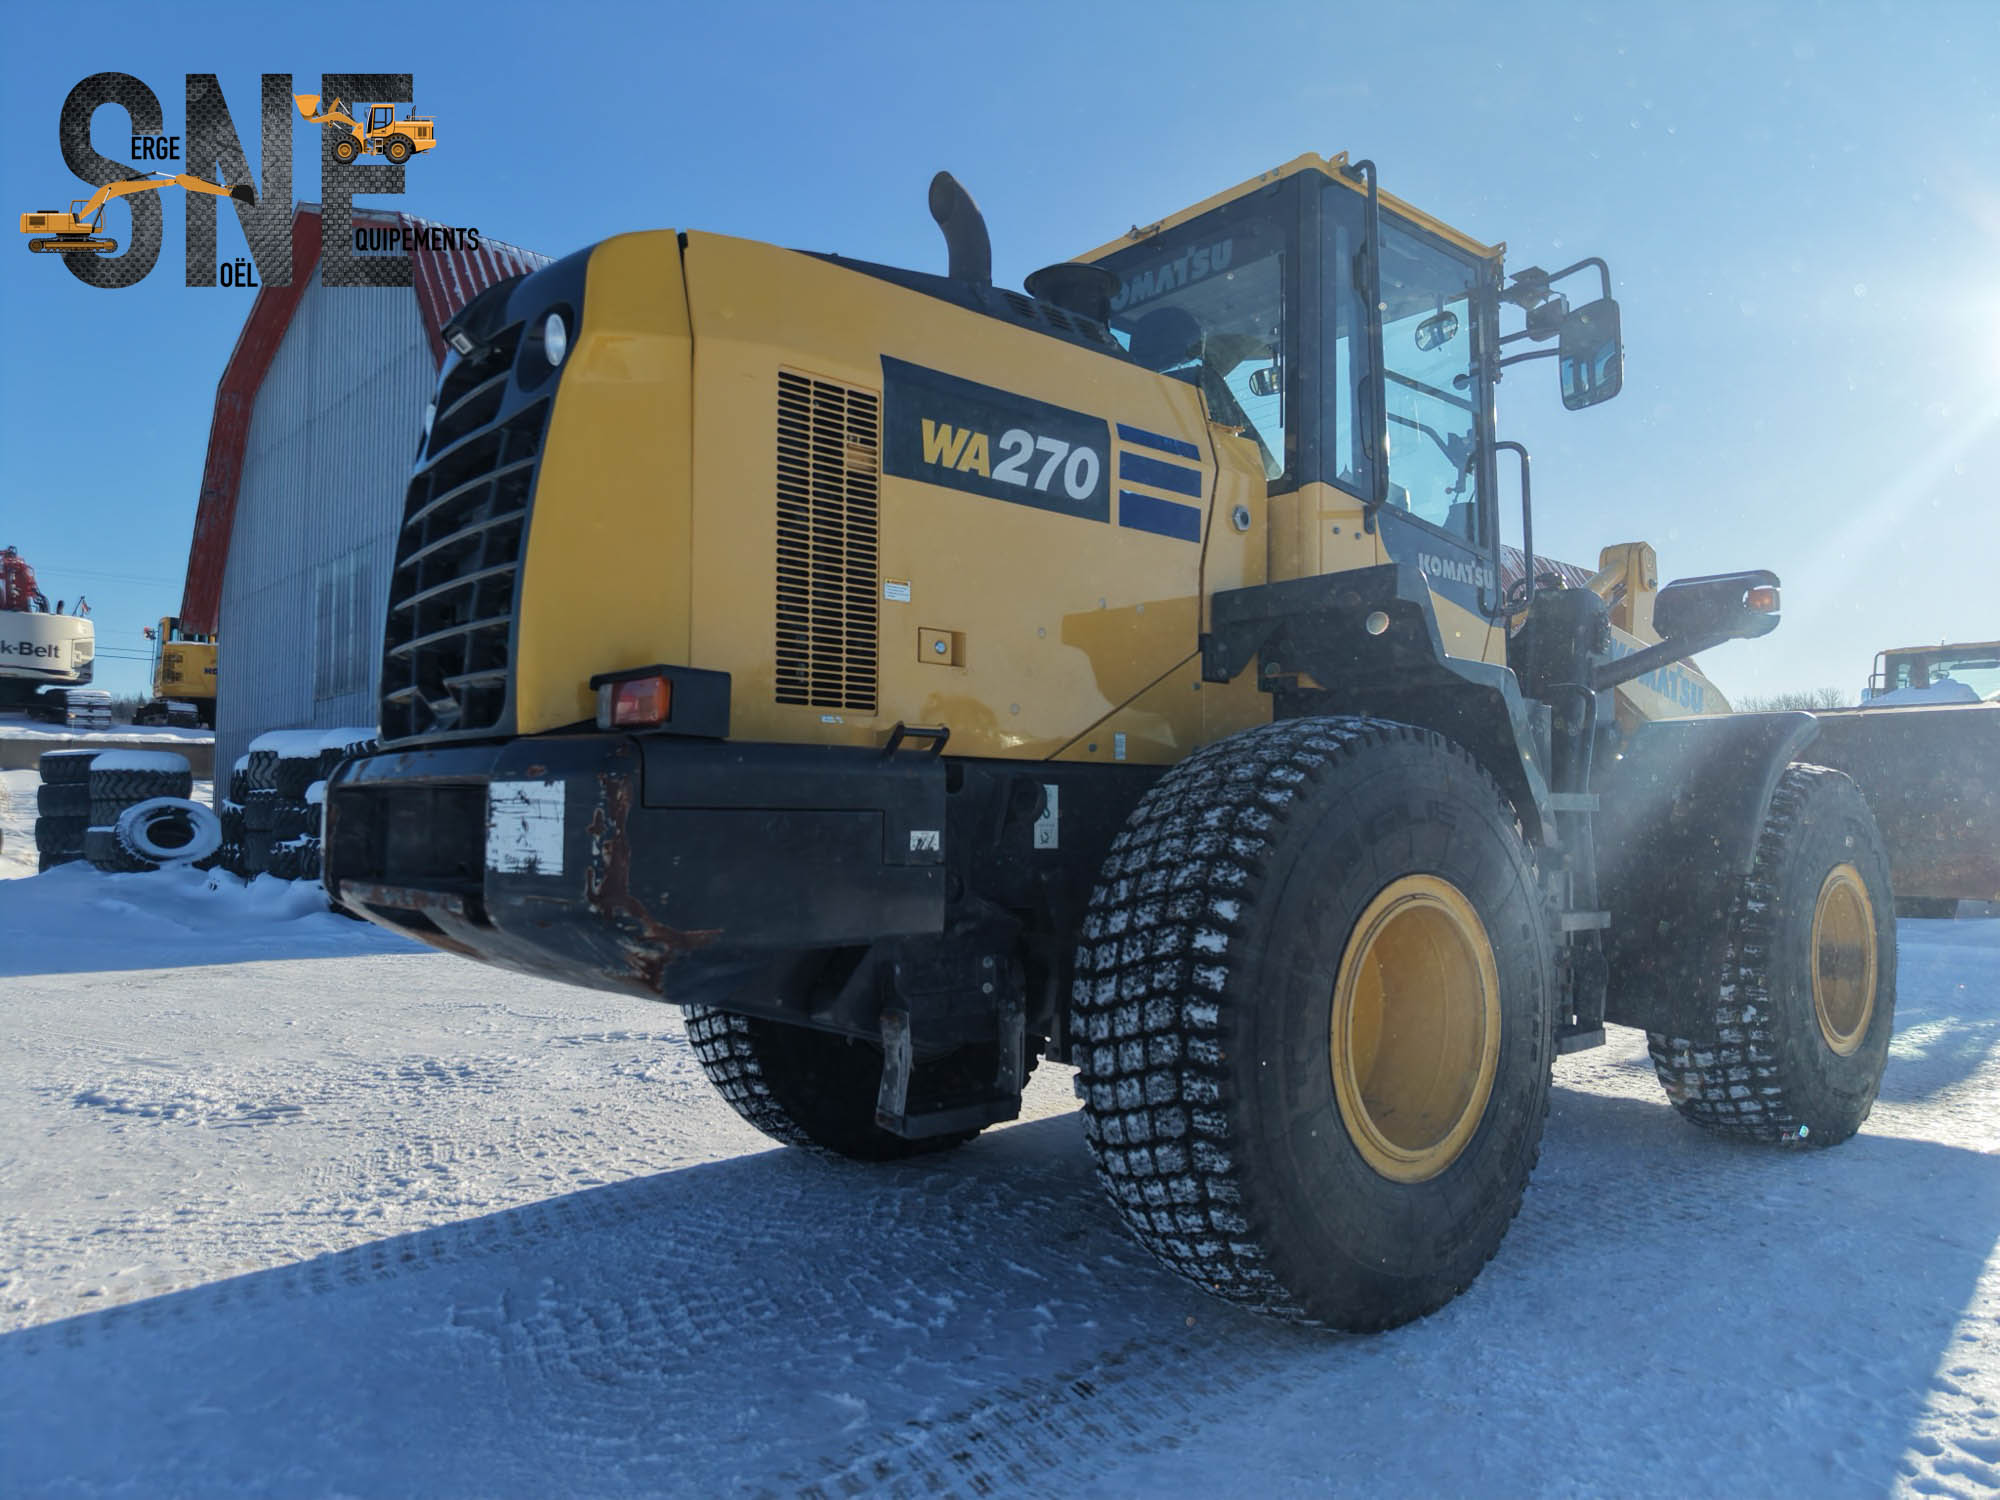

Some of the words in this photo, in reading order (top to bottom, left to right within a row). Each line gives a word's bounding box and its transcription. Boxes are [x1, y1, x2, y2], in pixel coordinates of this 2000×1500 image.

[1108, 238, 1232, 312] OMATSU
[920, 417, 1100, 500] WA270
[1418, 552, 1495, 590] KOMATSU
